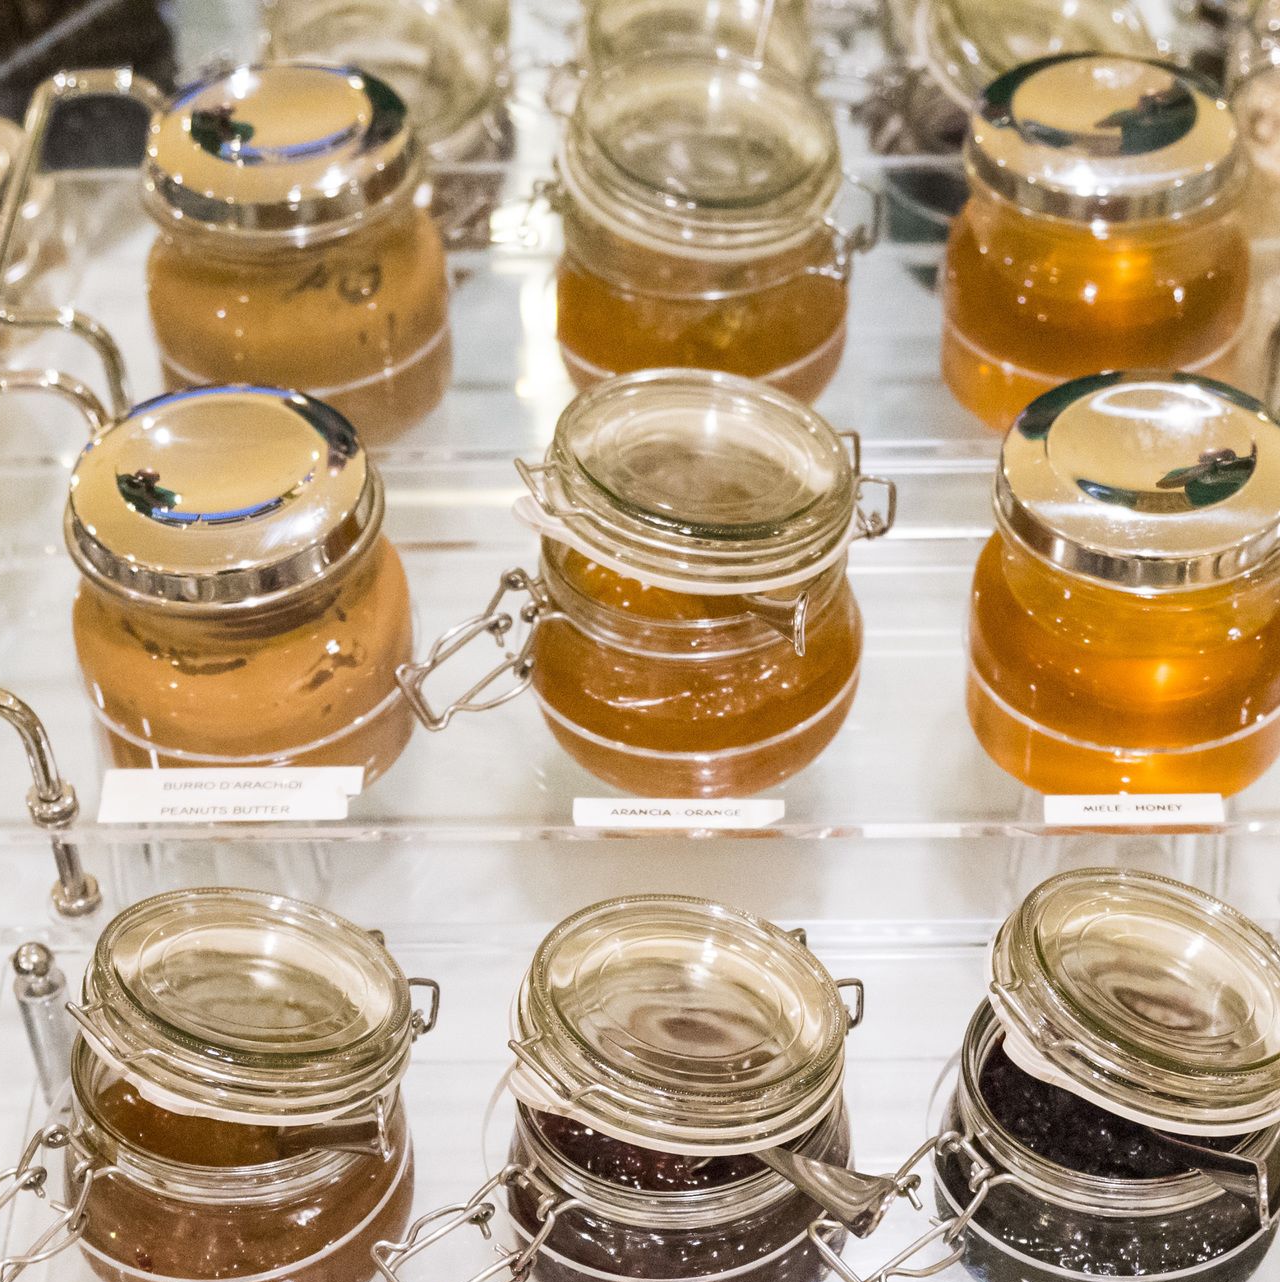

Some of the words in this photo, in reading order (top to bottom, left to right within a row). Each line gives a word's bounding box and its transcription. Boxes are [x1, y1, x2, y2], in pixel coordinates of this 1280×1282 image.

[162, 780, 216, 791] BURRO
[160, 805, 227, 816] PEANUTS
[232, 804, 291, 815] BUTTER
[610, 808, 672, 817] ARANCIA
[684, 808, 741, 817] ORANGE
[1082, 804, 1121, 812] MIELE
[1135, 804, 1183, 812] HONEY
